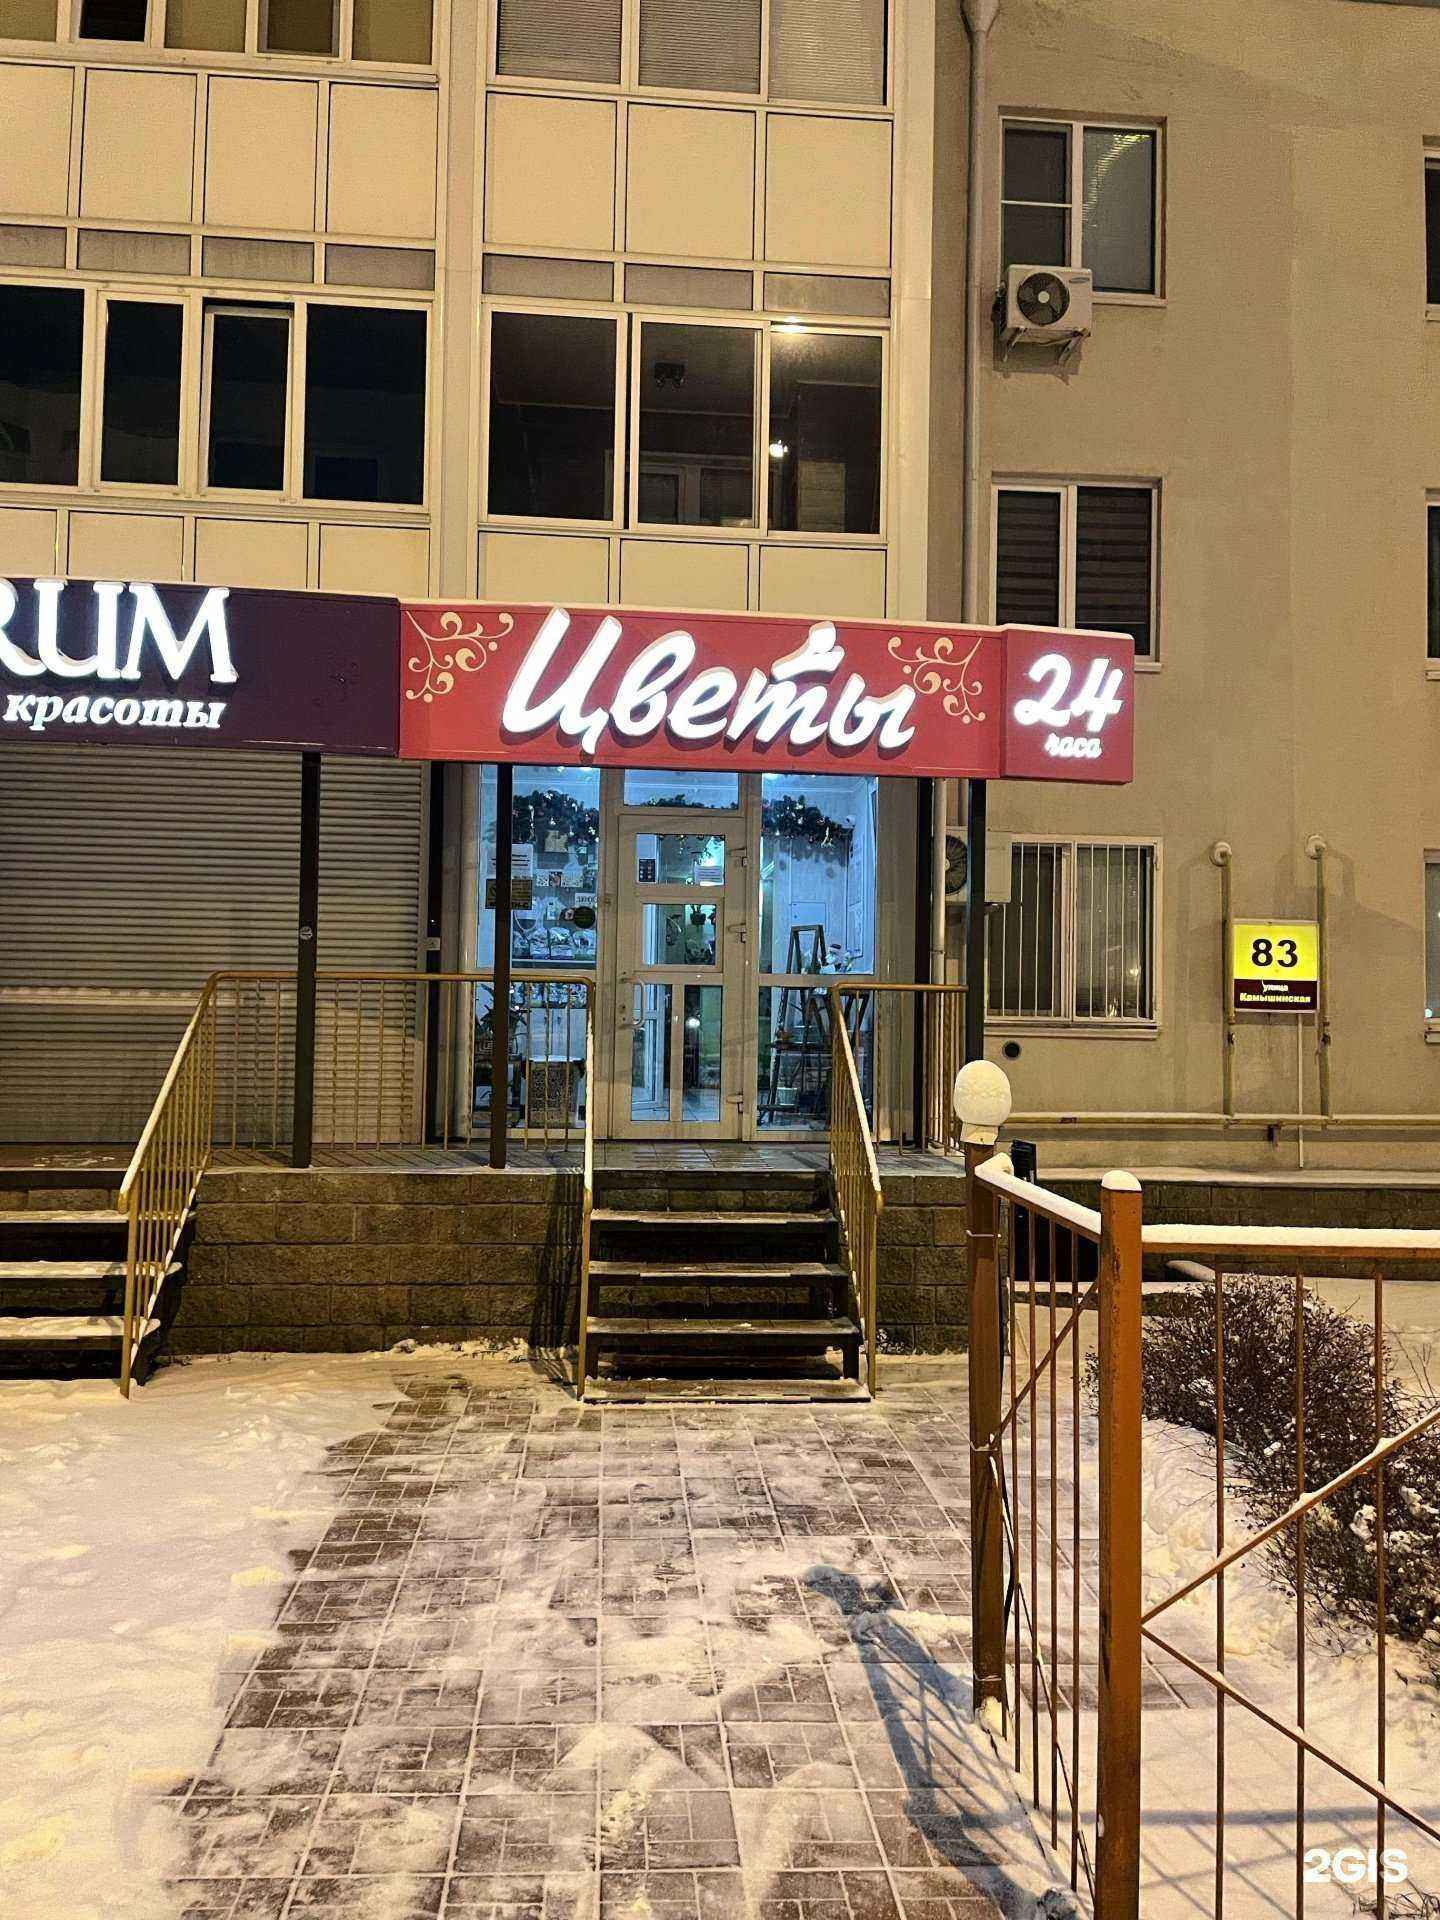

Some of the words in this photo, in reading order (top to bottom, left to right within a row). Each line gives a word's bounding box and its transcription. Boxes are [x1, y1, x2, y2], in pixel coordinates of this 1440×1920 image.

[502, 607, 915, 754] Цветы
[1014, 653, 1124, 732] 24
[2, 694, 227, 731] красоты
[1044, 732, 1102, 758] часа
[1251, 938, 1298, 967] 83
